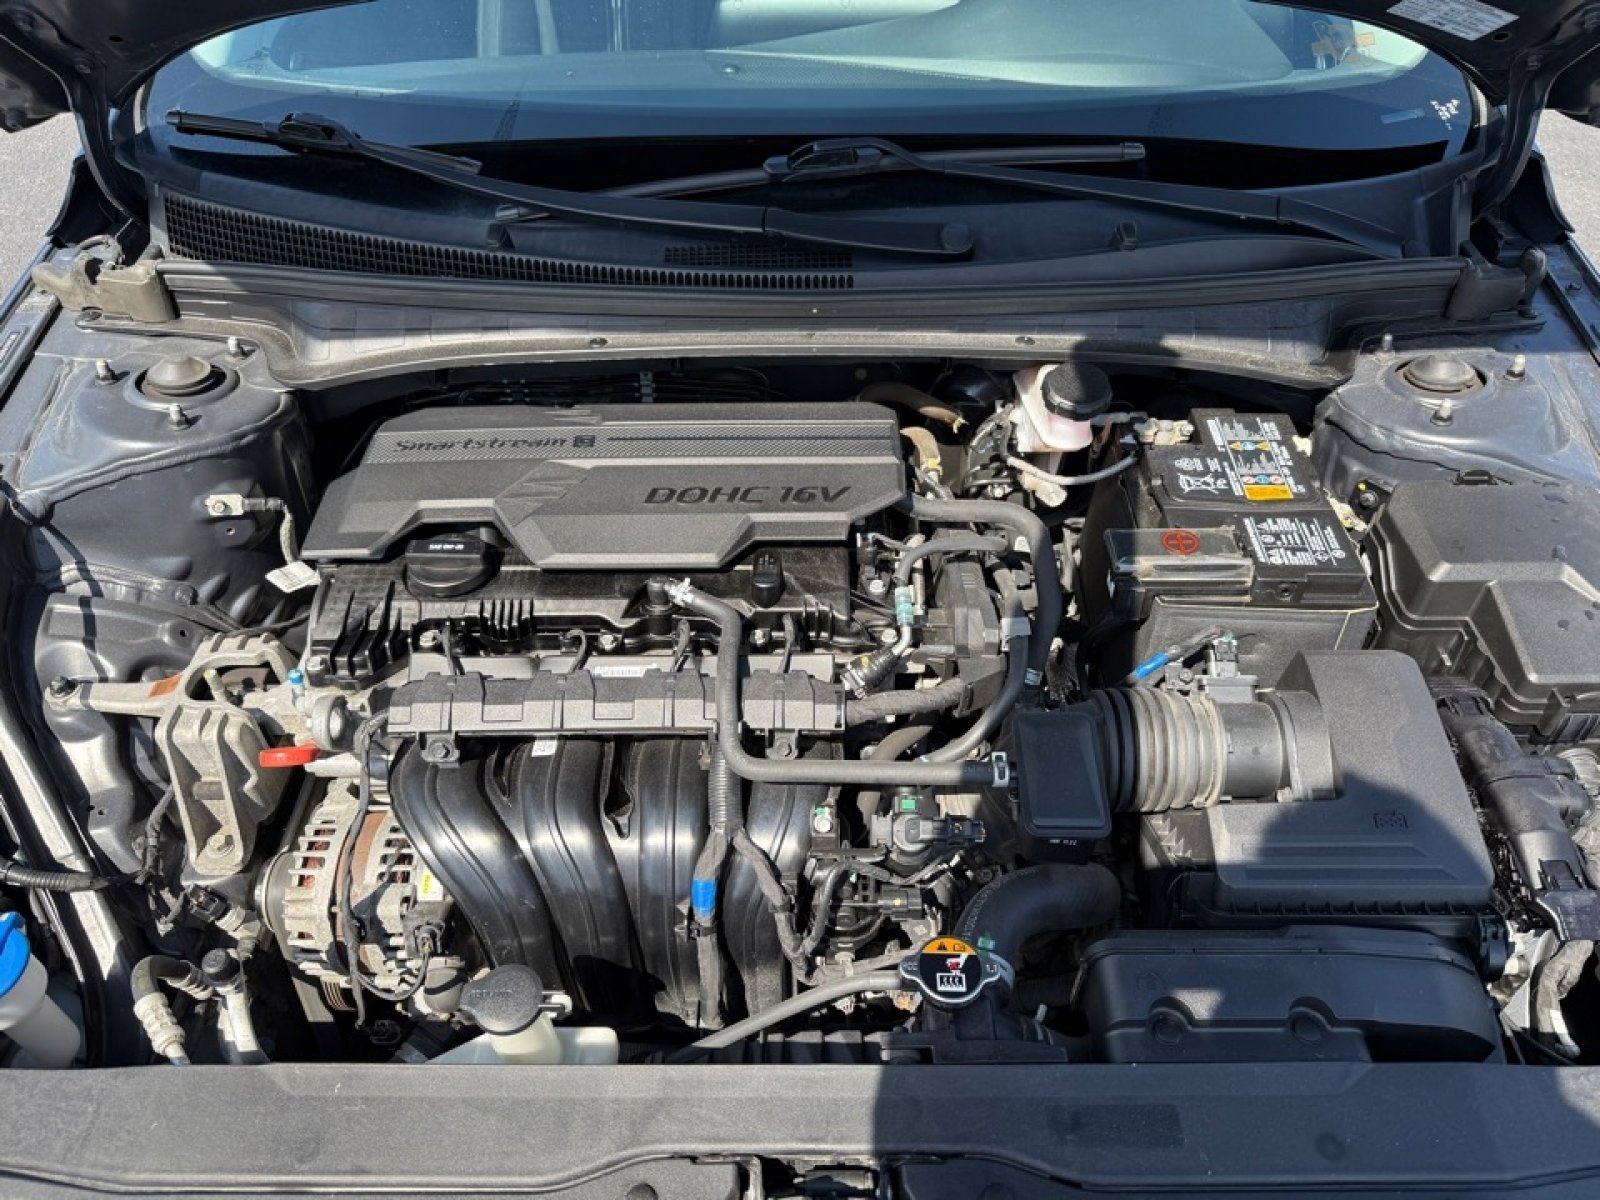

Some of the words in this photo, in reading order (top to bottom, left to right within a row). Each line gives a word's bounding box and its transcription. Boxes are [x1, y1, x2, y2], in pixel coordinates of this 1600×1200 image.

[394, 436, 567, 452] Smartstream
[644, 486, 770, 504] DOHC
[779, 486, 852, 503] 16V
